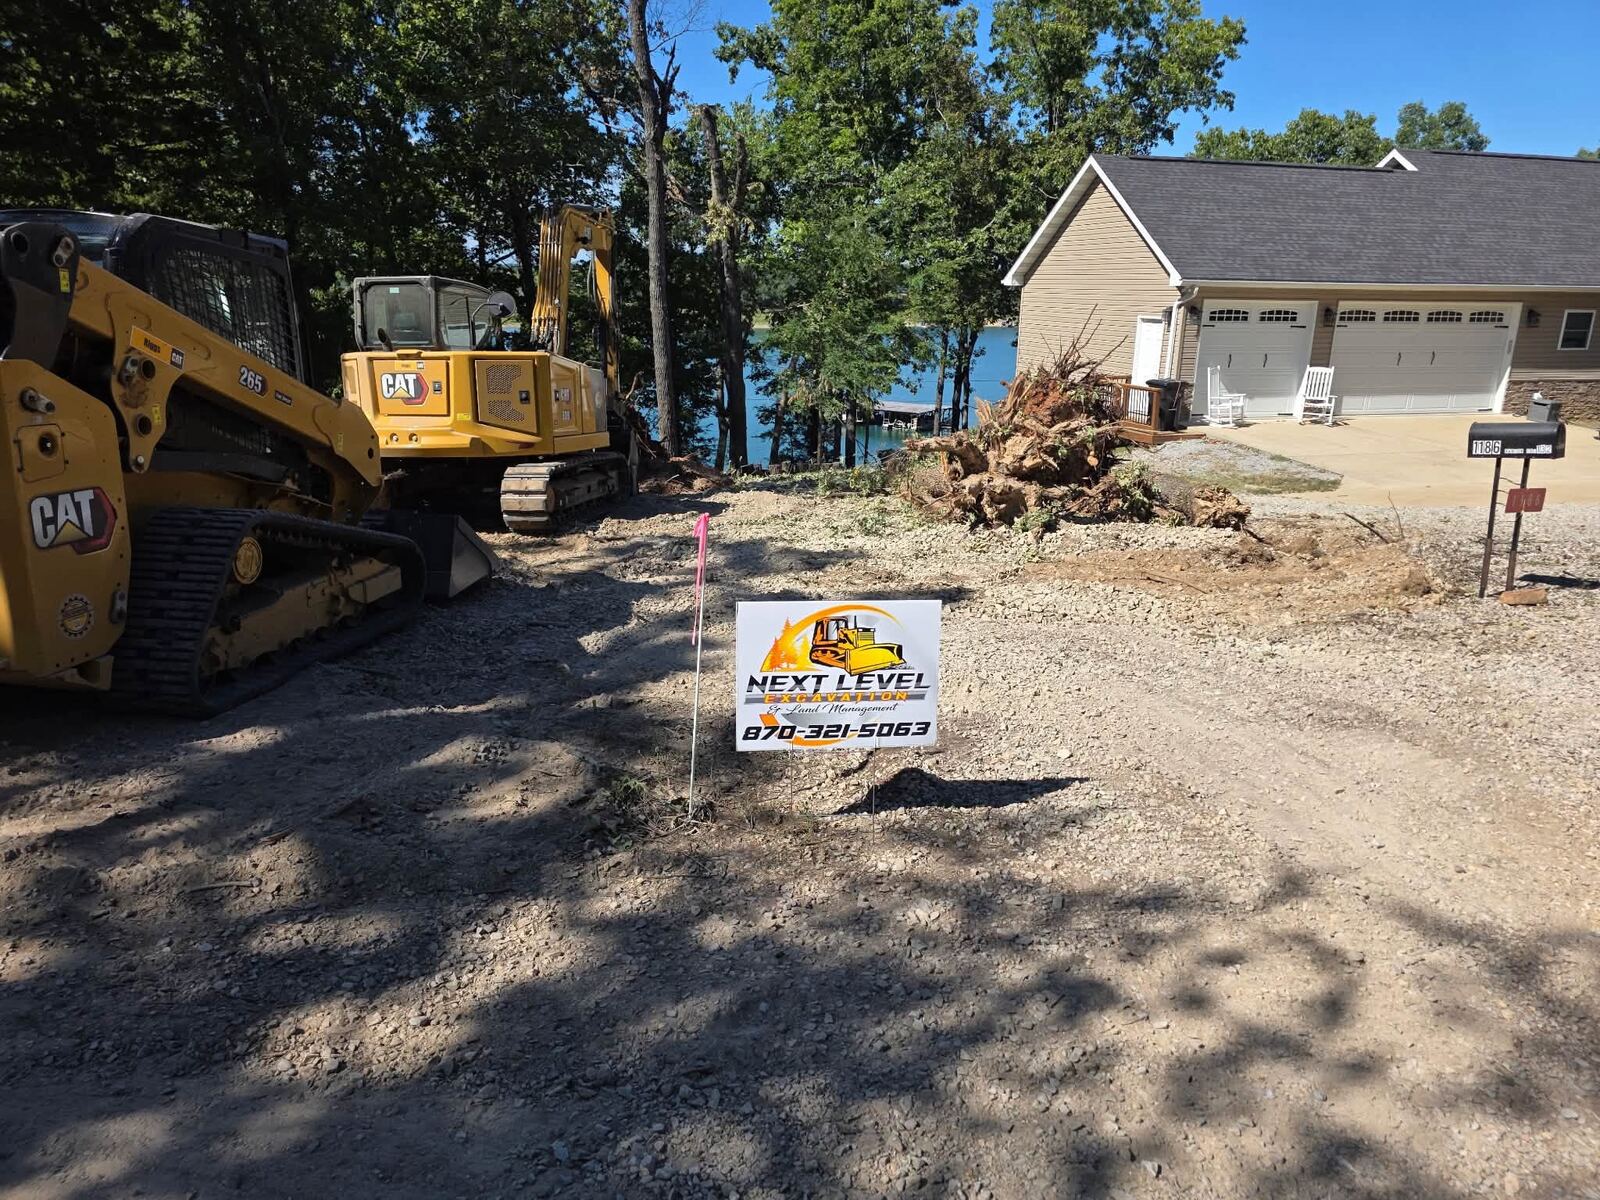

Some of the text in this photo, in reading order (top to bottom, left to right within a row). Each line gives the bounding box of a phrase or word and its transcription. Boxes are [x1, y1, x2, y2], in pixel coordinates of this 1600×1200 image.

[239, 366, 263, 394] 265
[381, 373, 417, 399] CAT
[1473, 441, 1500, 454] 1186
[30, 489, 95, 548] CAT
[746, 673, 931, 694] NEXT LEVEL
[763, 691, 909, 704] EXCAVATION
[767, 703, 899, 716] & Land Management
[742, 721, 931, 741] 870-321-5063
